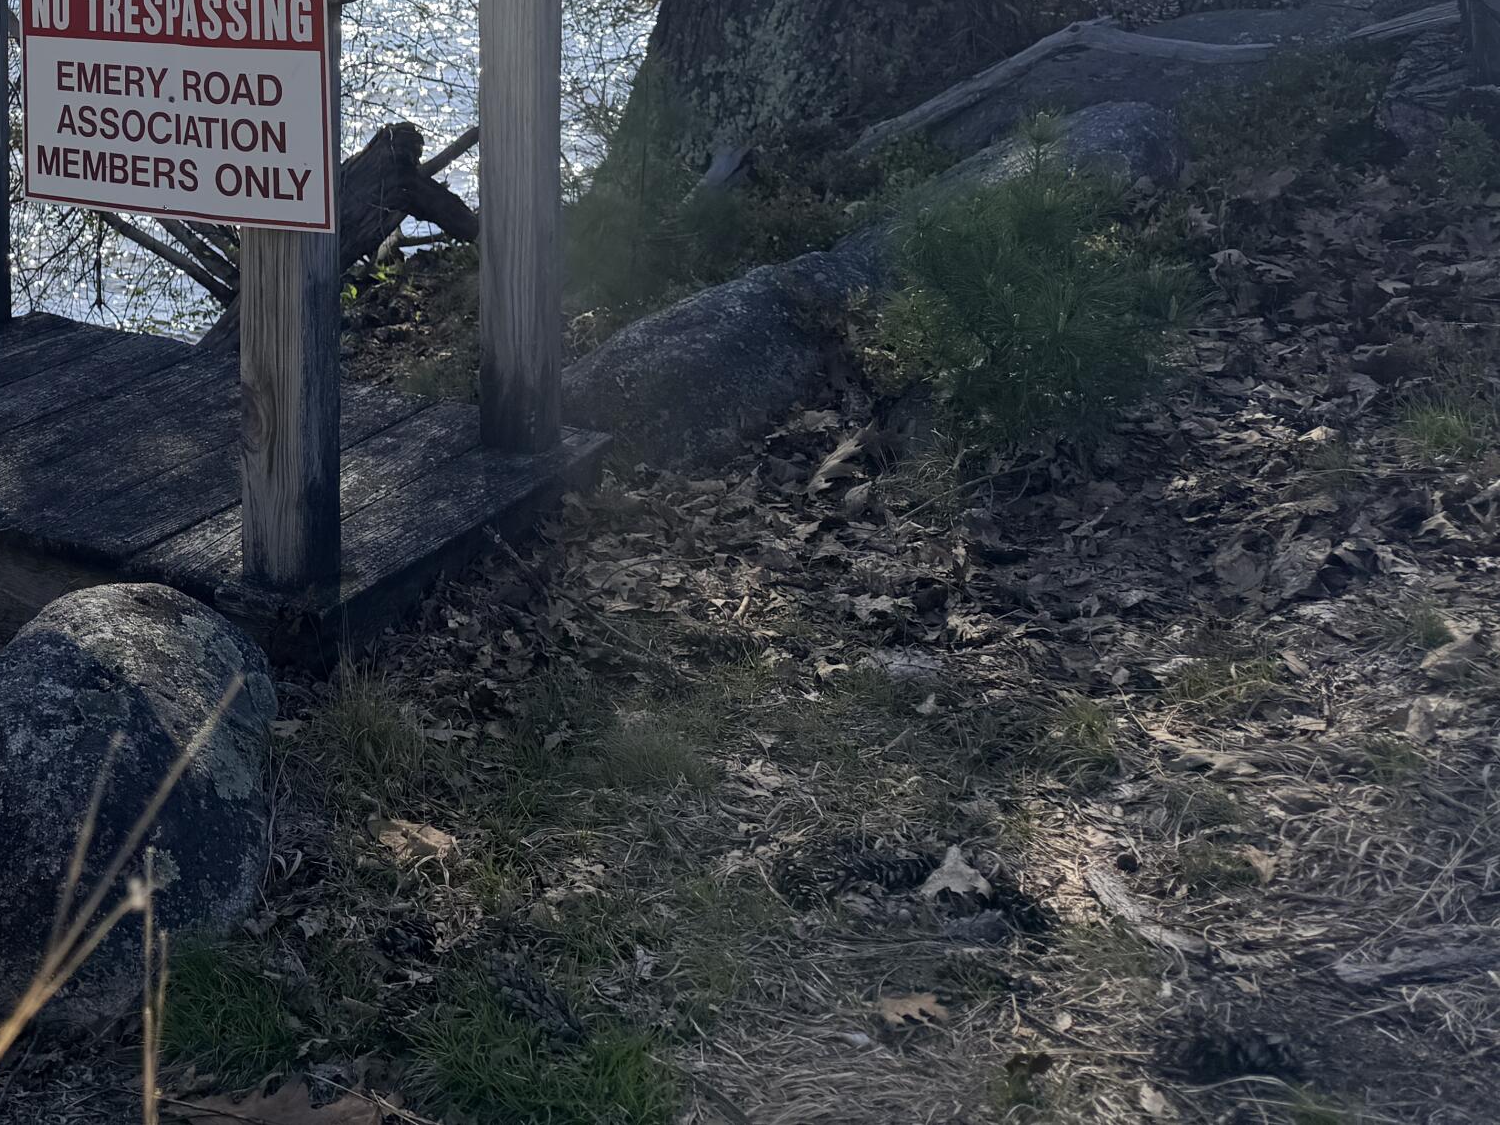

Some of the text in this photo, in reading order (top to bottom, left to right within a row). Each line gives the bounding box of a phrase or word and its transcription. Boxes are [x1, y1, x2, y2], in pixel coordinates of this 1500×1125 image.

[57, 61, 283, 106] EMERY ROAD
[57, 105, 287, 153] ASSOCIATION
[37, 145, 312, 201] MEMBERS ONLY
